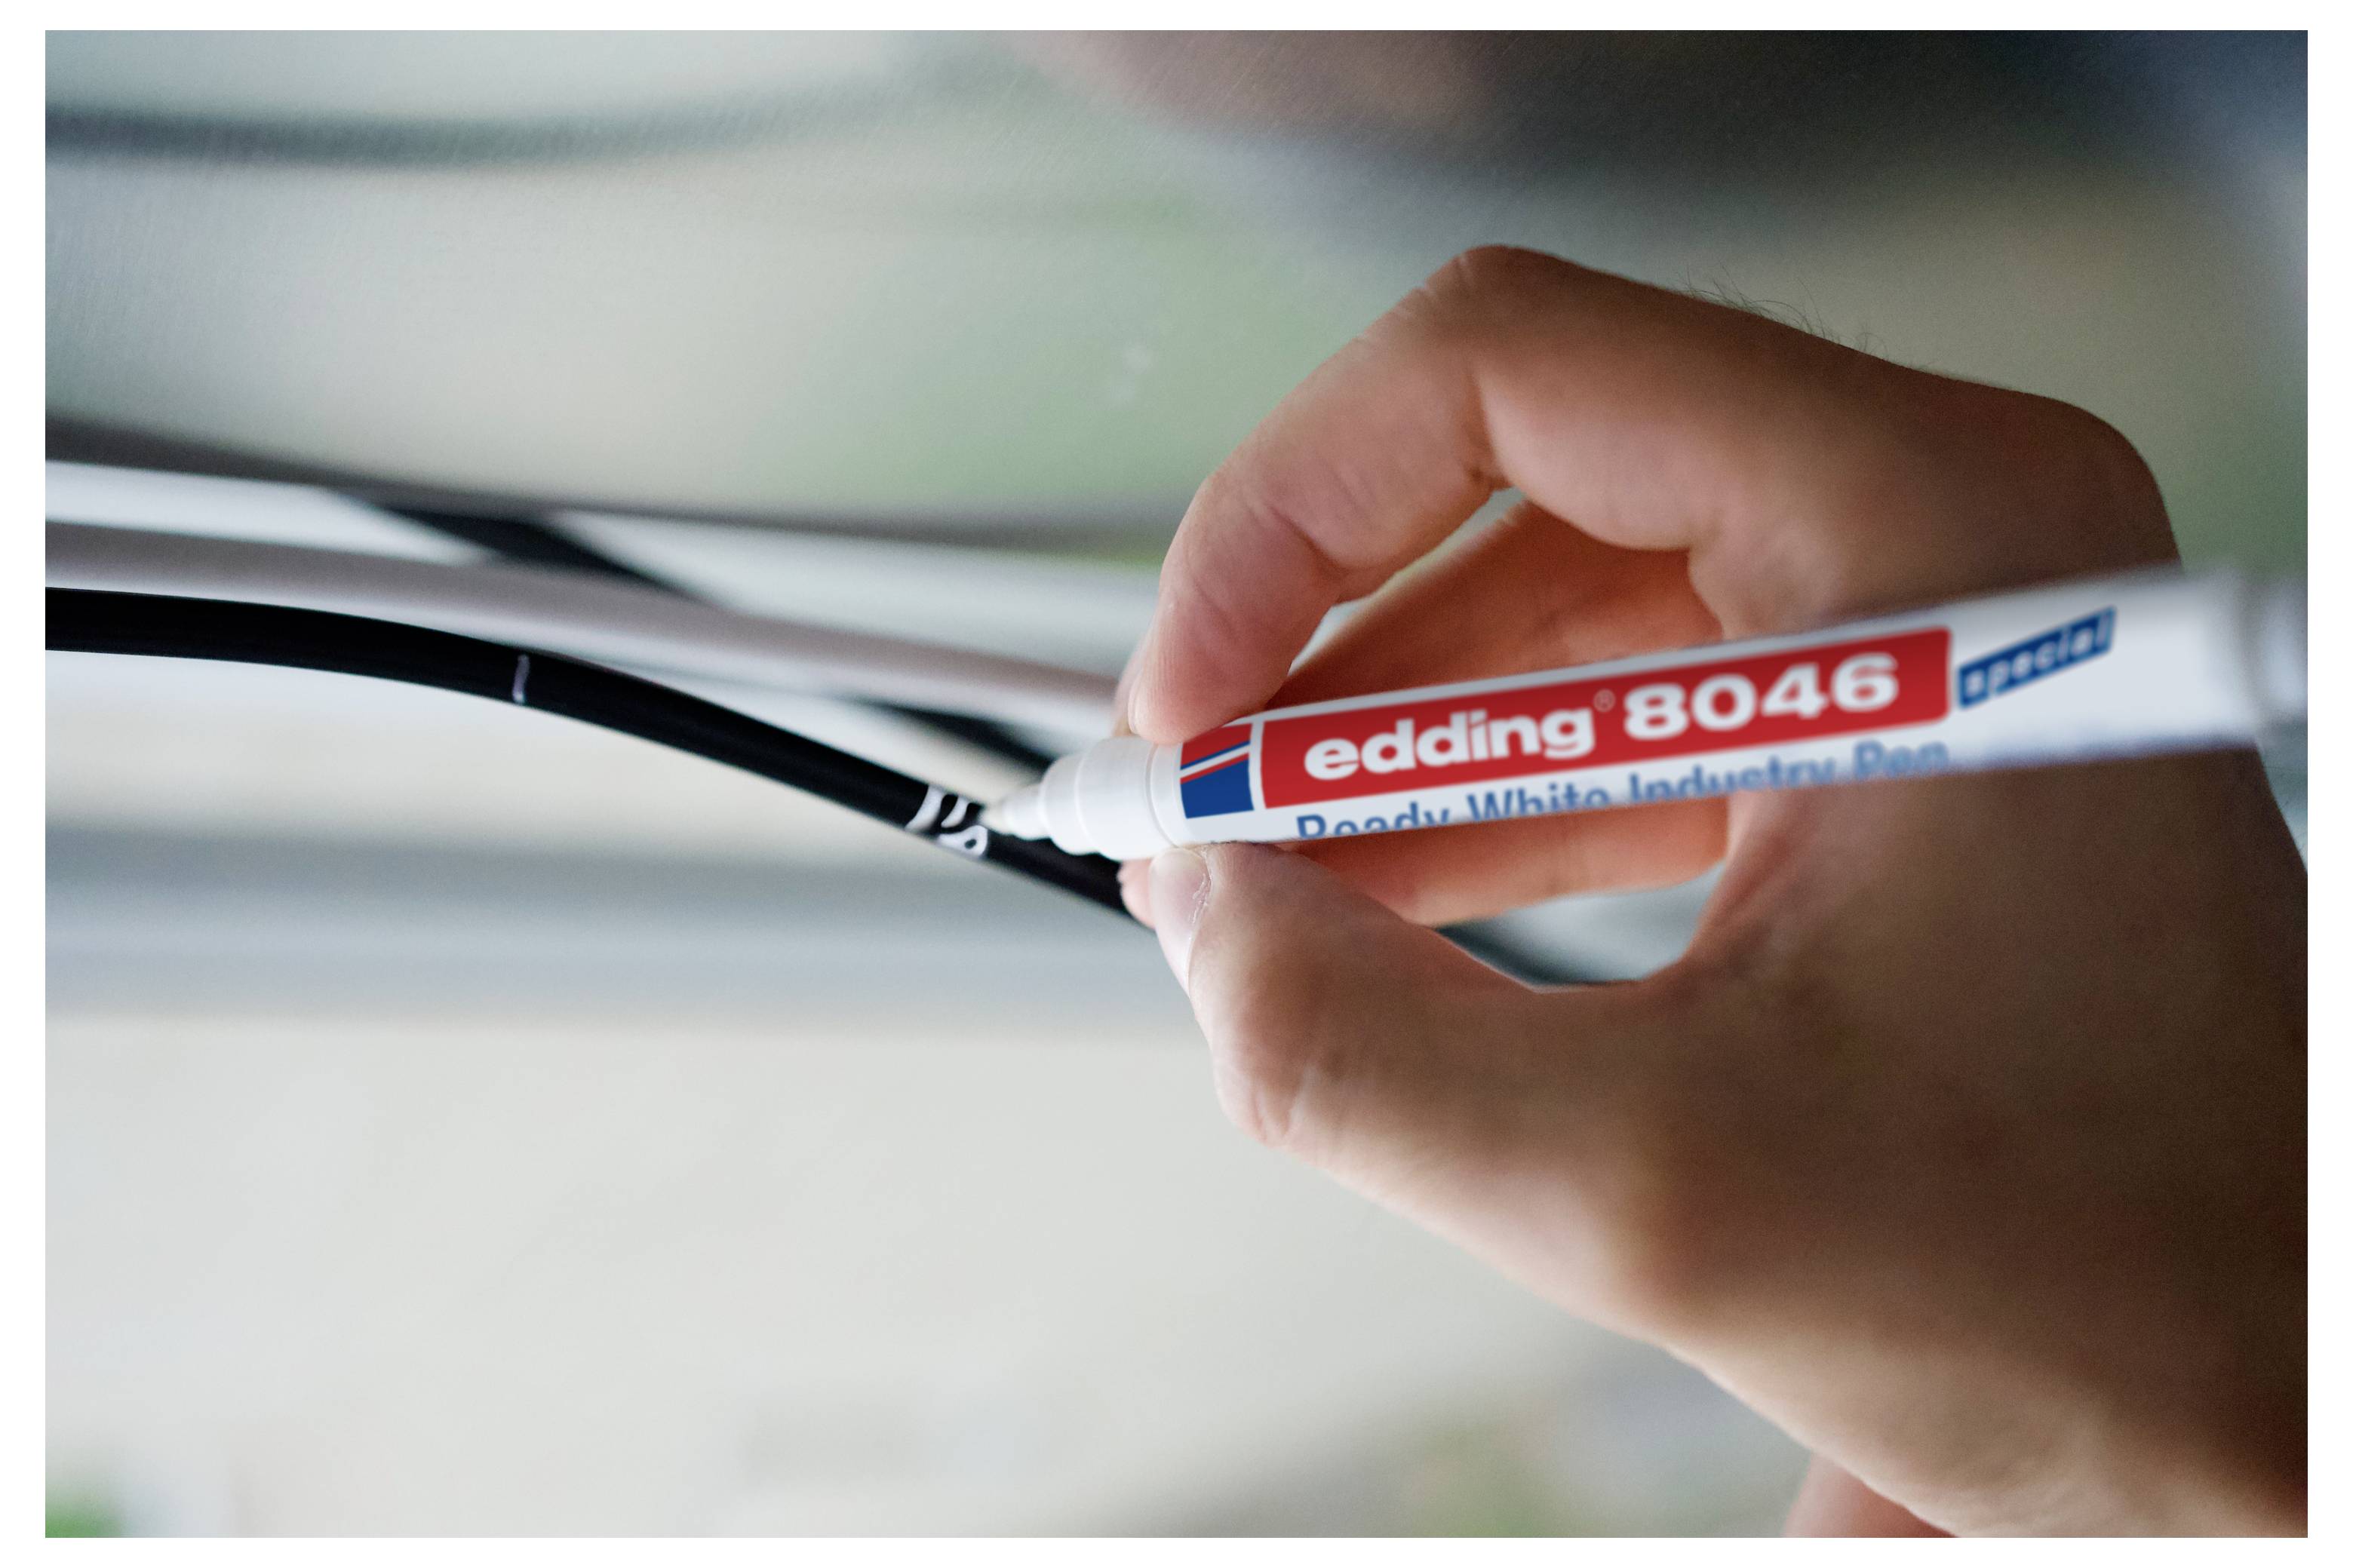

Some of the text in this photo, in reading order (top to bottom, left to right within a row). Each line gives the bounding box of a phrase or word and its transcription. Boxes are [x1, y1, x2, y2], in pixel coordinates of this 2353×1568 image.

[1964, 612, 2112, 698] special
[1304, 653, 1899, 781] edding 8046
